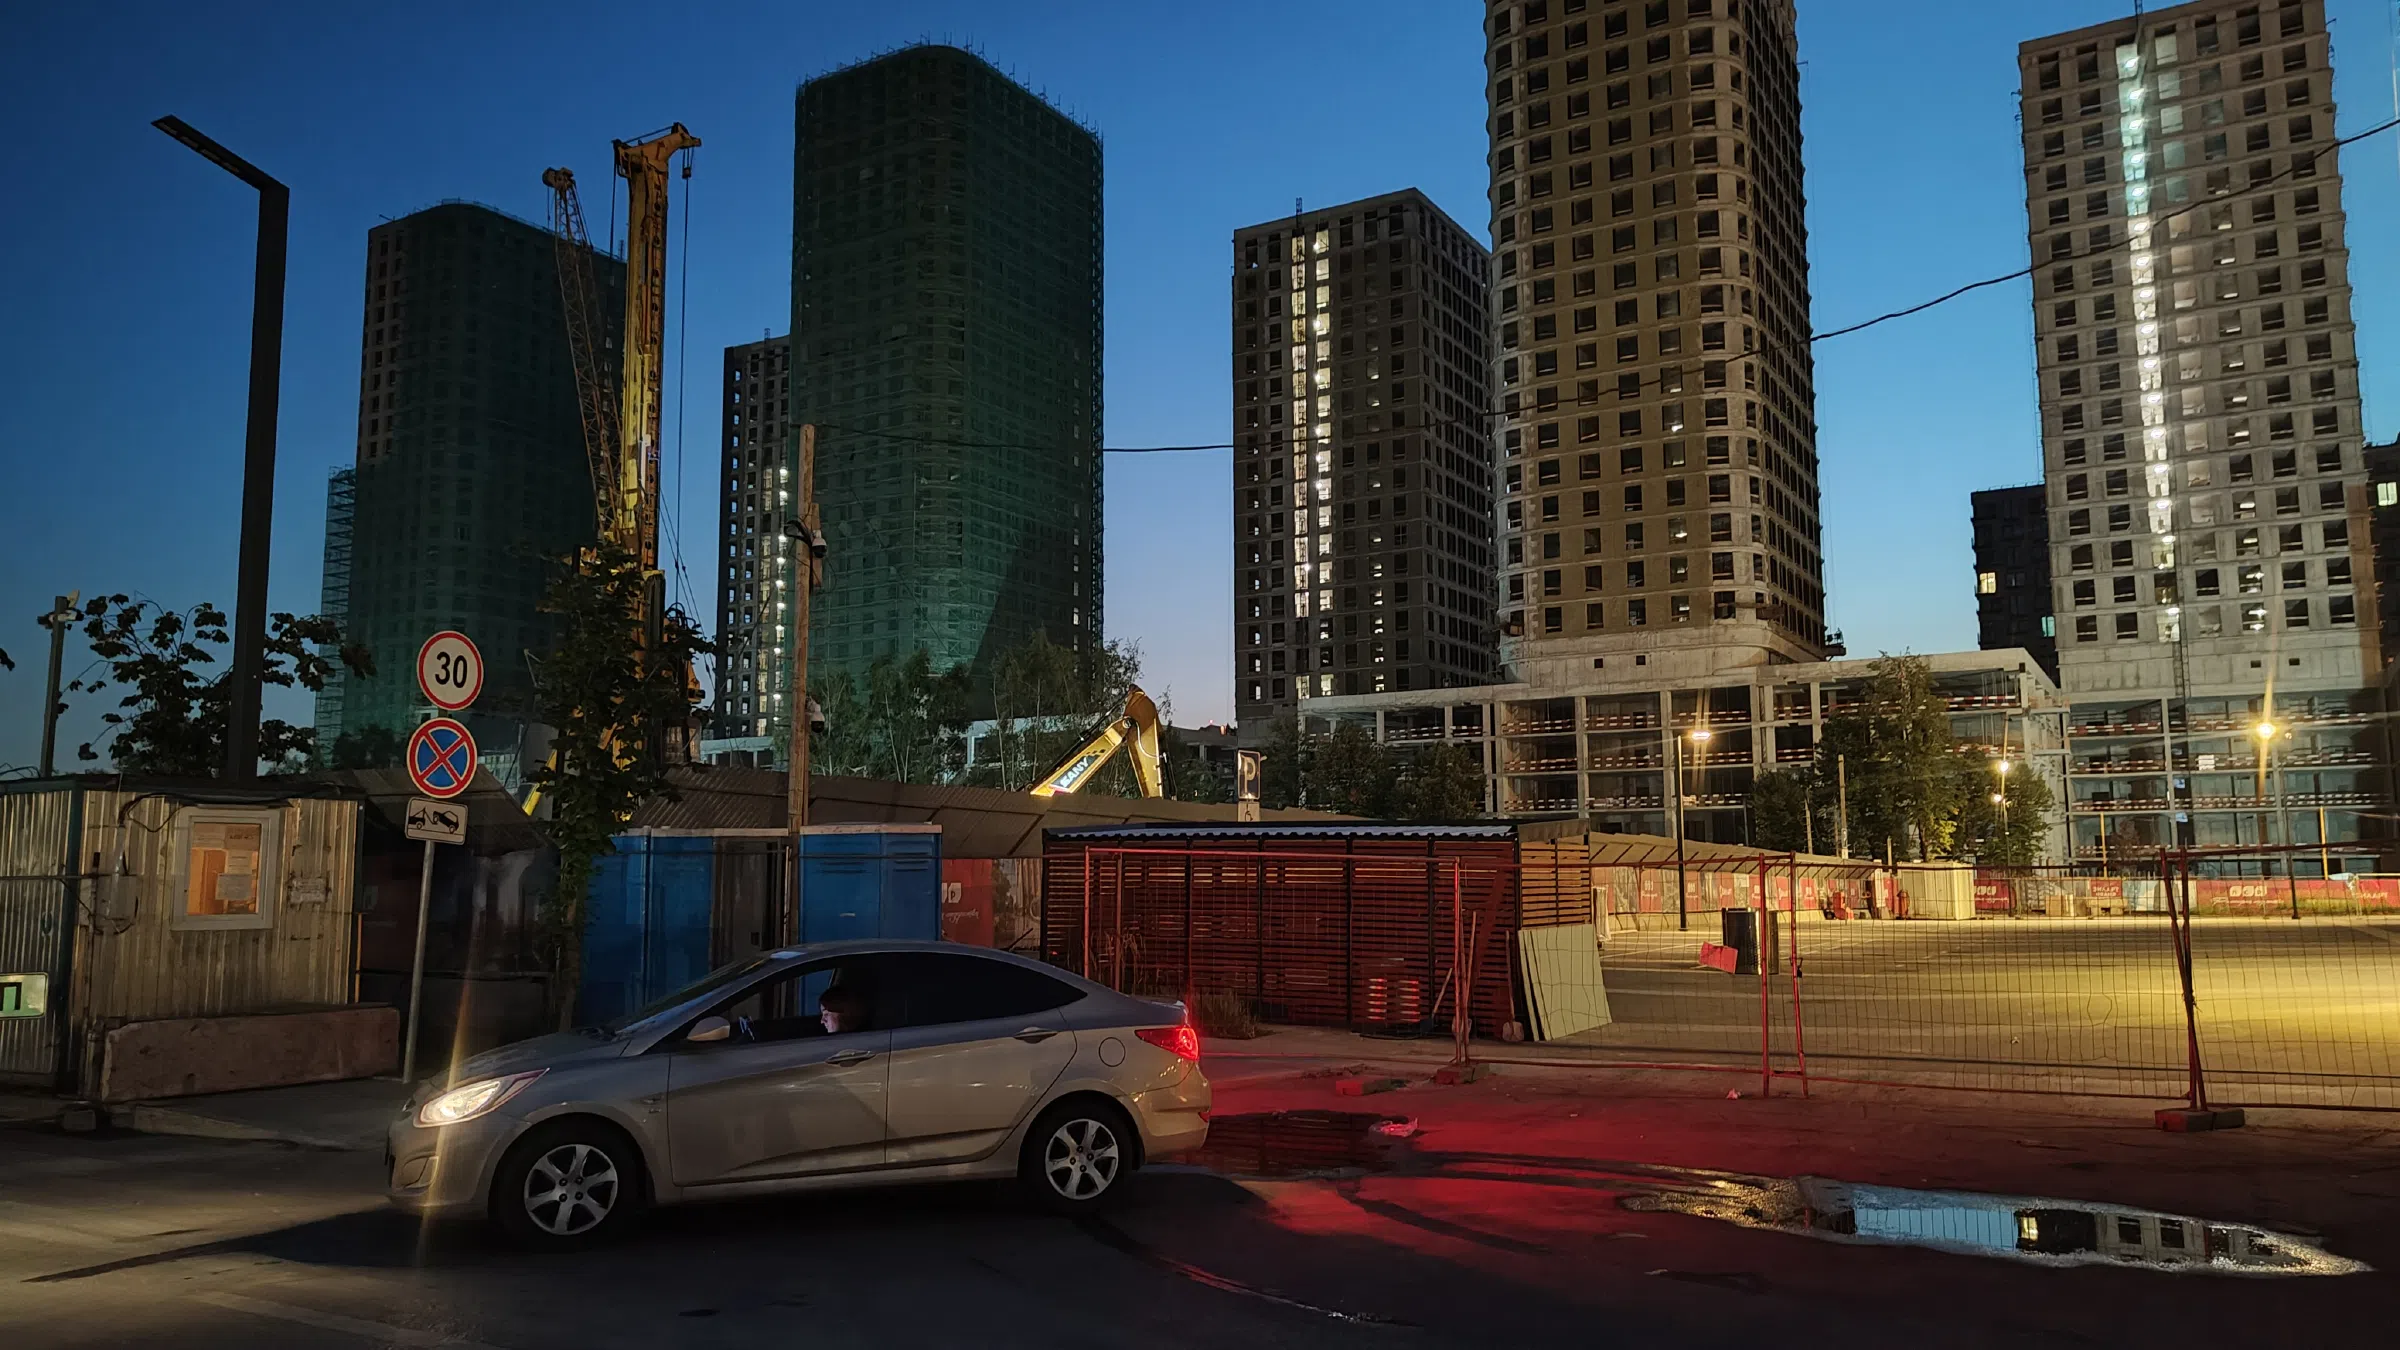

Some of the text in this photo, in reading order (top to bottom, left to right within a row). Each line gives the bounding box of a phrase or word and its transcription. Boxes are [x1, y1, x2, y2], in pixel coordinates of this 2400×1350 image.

[435, 651, 468, 689] 30
[1060, 757, 1089, 788] SANY
[1241, 756, 1256, 794] P
